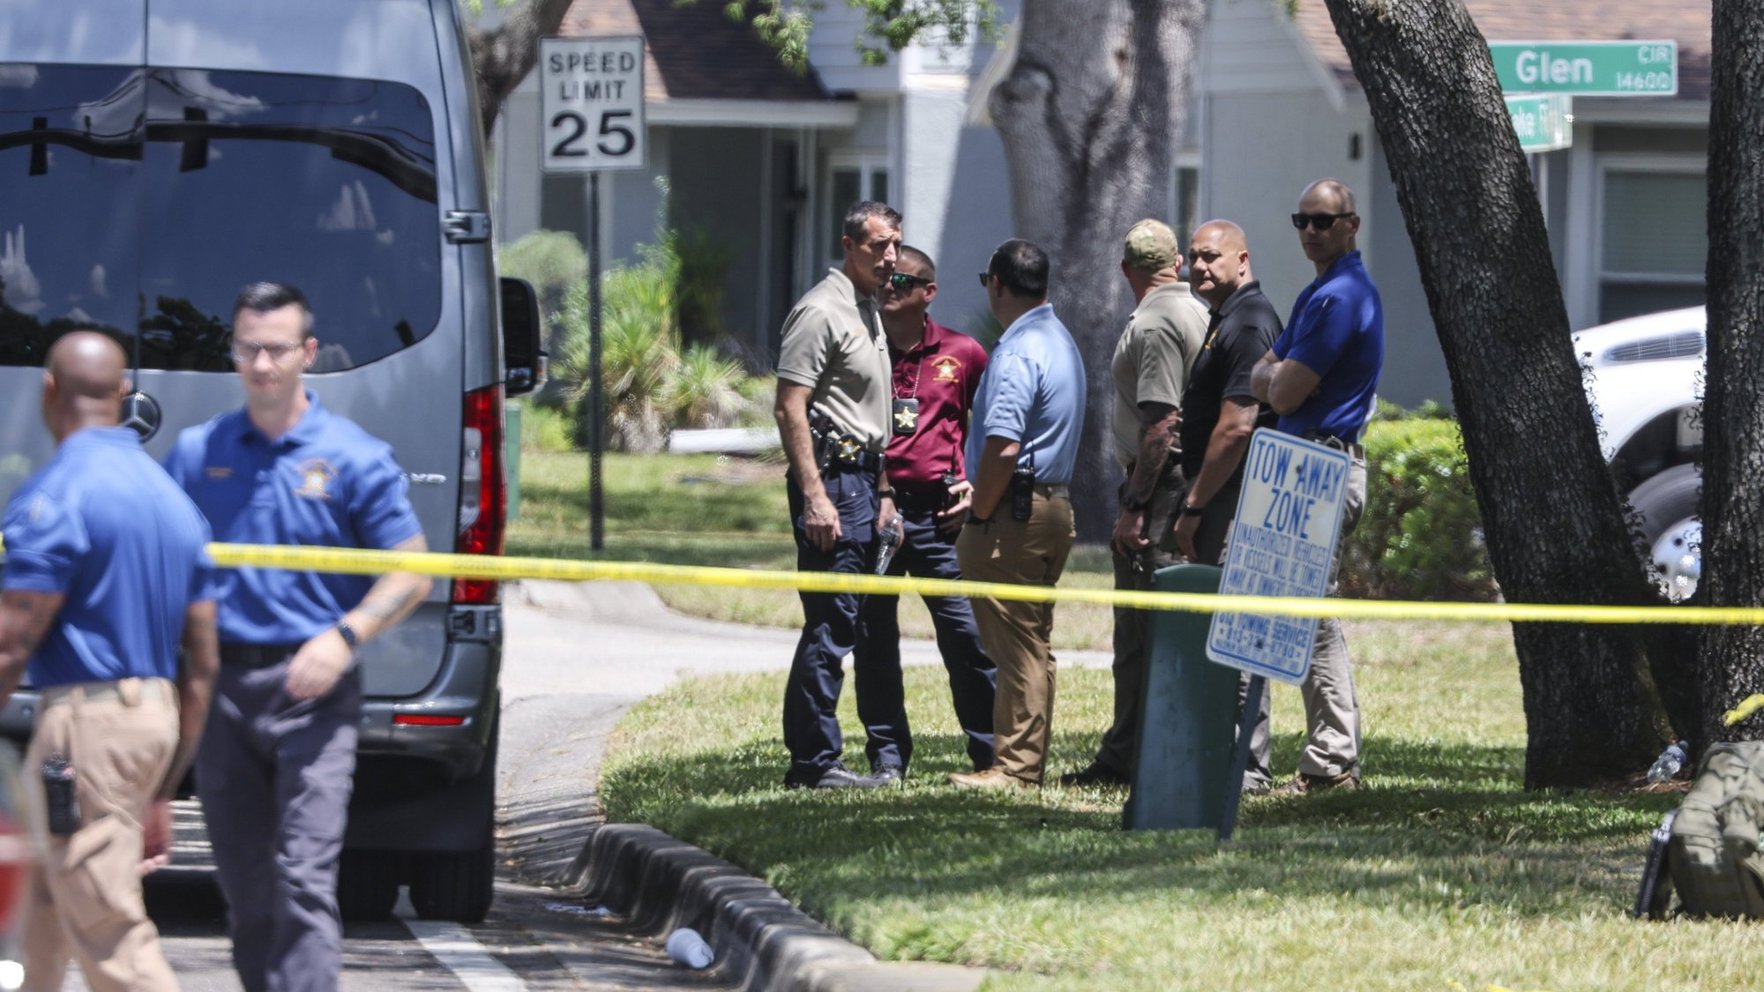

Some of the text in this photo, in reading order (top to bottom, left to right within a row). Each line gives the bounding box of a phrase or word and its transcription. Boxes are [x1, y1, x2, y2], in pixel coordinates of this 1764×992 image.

[549, 51, 635, 73] SPEED
[1516, 50, 1593, 84] Glen
[1638, 46, 1668, 63] CIR
[560, 81, 625, 101] LIMIT
[1617, 72, 1670, 89] 14600
[551, 110, 635, 156] 25
[1253, 440, 1344, 503] TOW AWAY
[1263, 488, 1315, 539] ZONE
[1271, 620, 1309, 648] SERVICE
